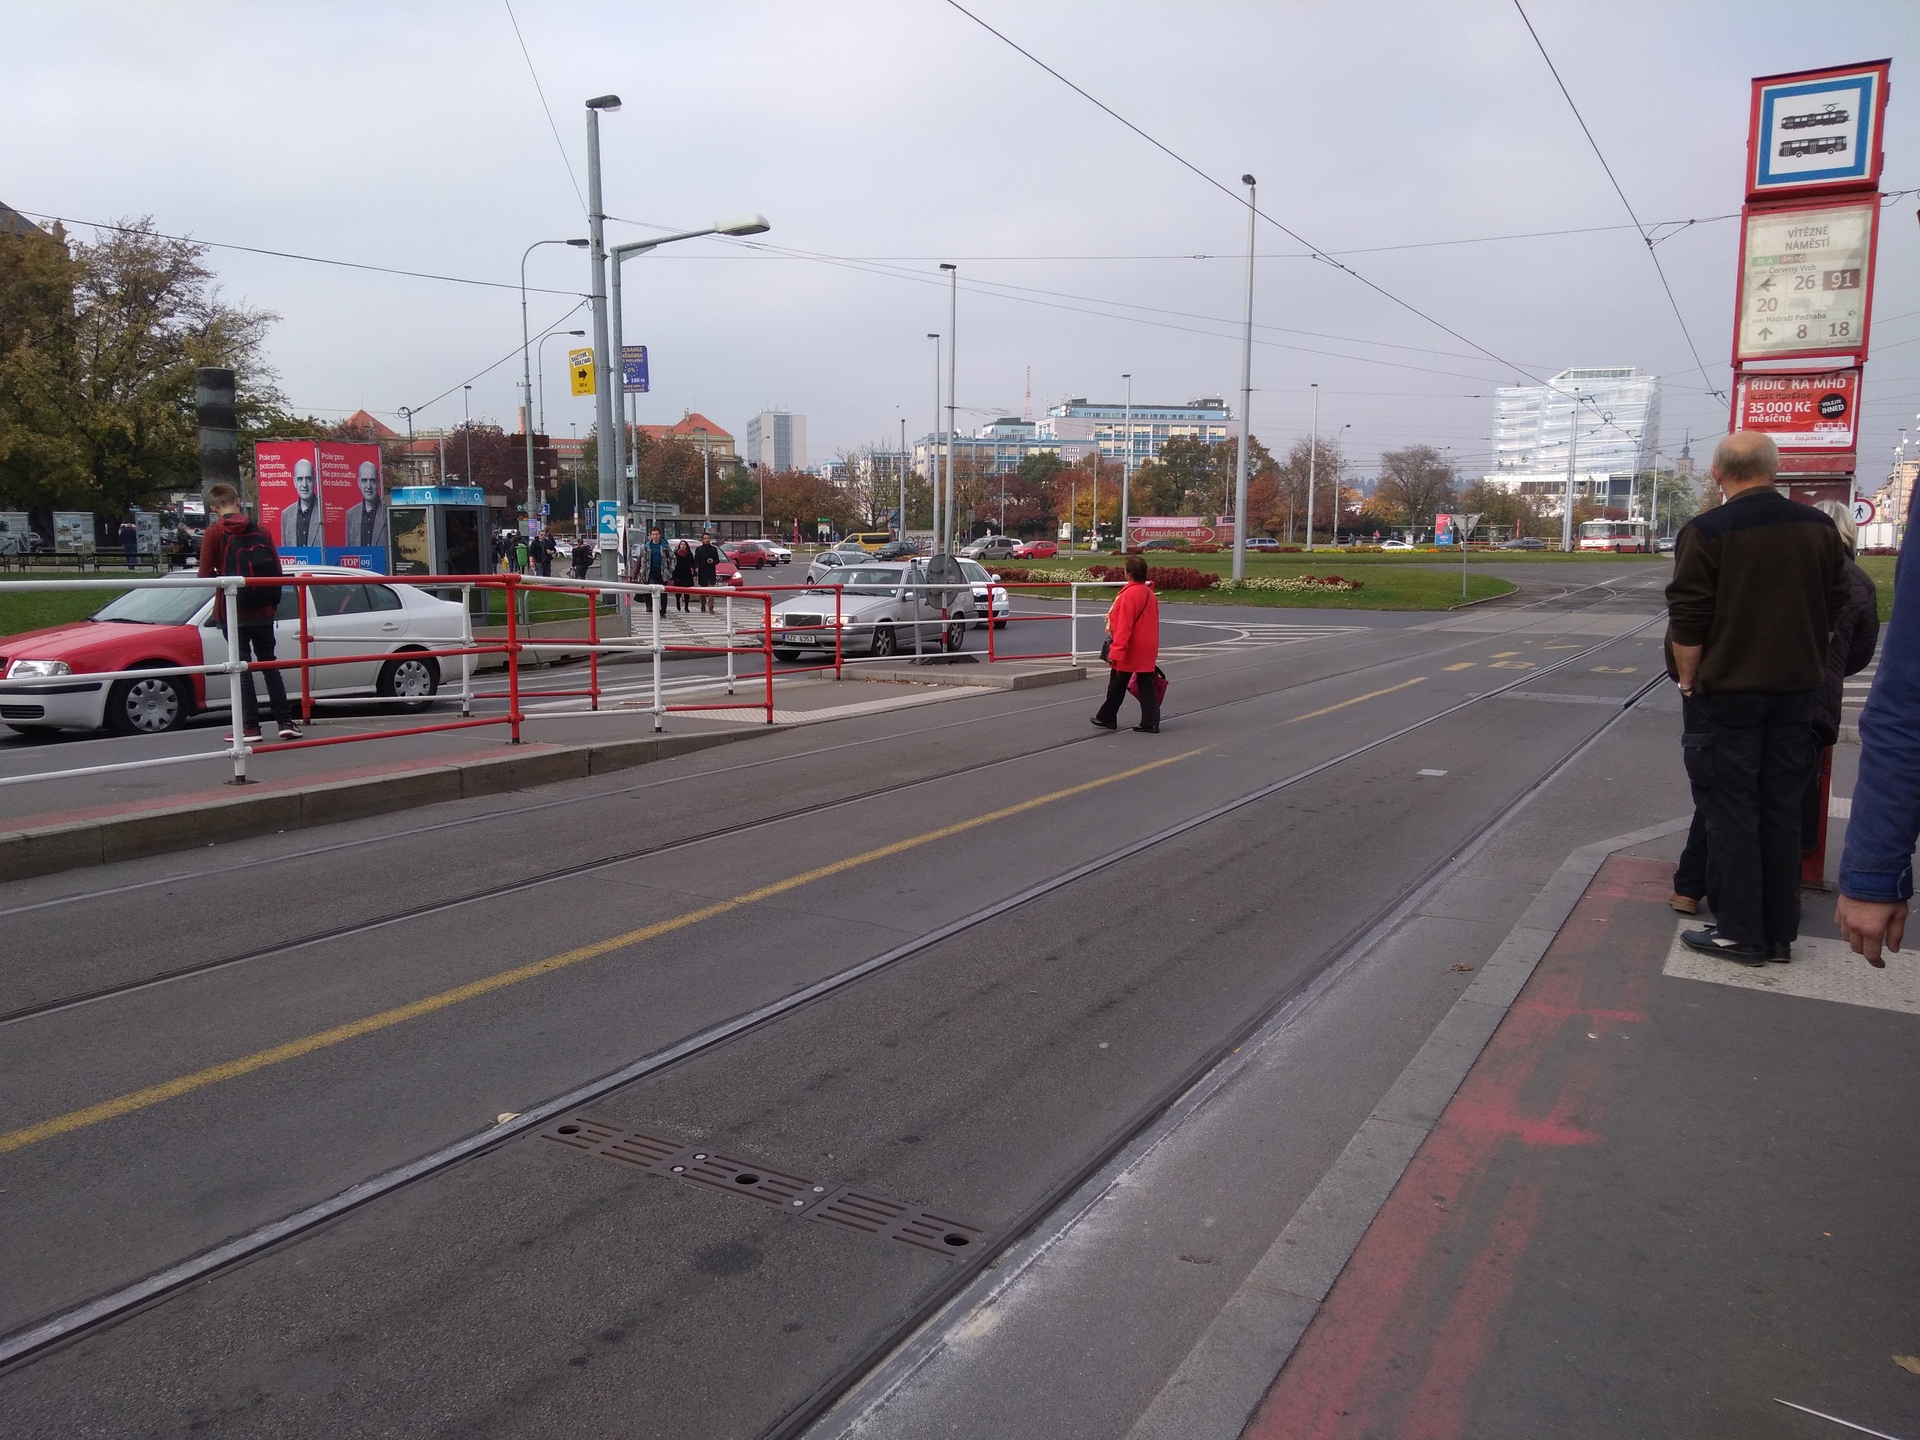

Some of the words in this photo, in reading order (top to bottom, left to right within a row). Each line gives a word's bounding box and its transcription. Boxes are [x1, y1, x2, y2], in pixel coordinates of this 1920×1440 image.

[1788, 226, 1829, 238] VÍTĚZNÉ
[1785, 238, 1830, 251] NÁMĚSTÍ
[1768, 266, 1798, 274] Červený
[1794, 274, 1816, 290] 26
[1831, 272, 1852, 288] 91
[1756, 297, 1778, 313] 20
[1766, 314, 1793, 322] Nádraží
[1797, 324, 1807, 339] 8
[1829, 322, 1850, 337] 18
[1813, 378, 1846, 389] MHD
[1749, 402, 1764, 414] 35
[1766, 402, 1792, 413] 000
[1795, 401, 1811, 412] Kč
[1822, 405, 1845, 414] IHNED
[1749, 413, 1792, 422] měsíčně
[343, 558, 359, 566] TOP
[361, 559, 370, 568] 09
